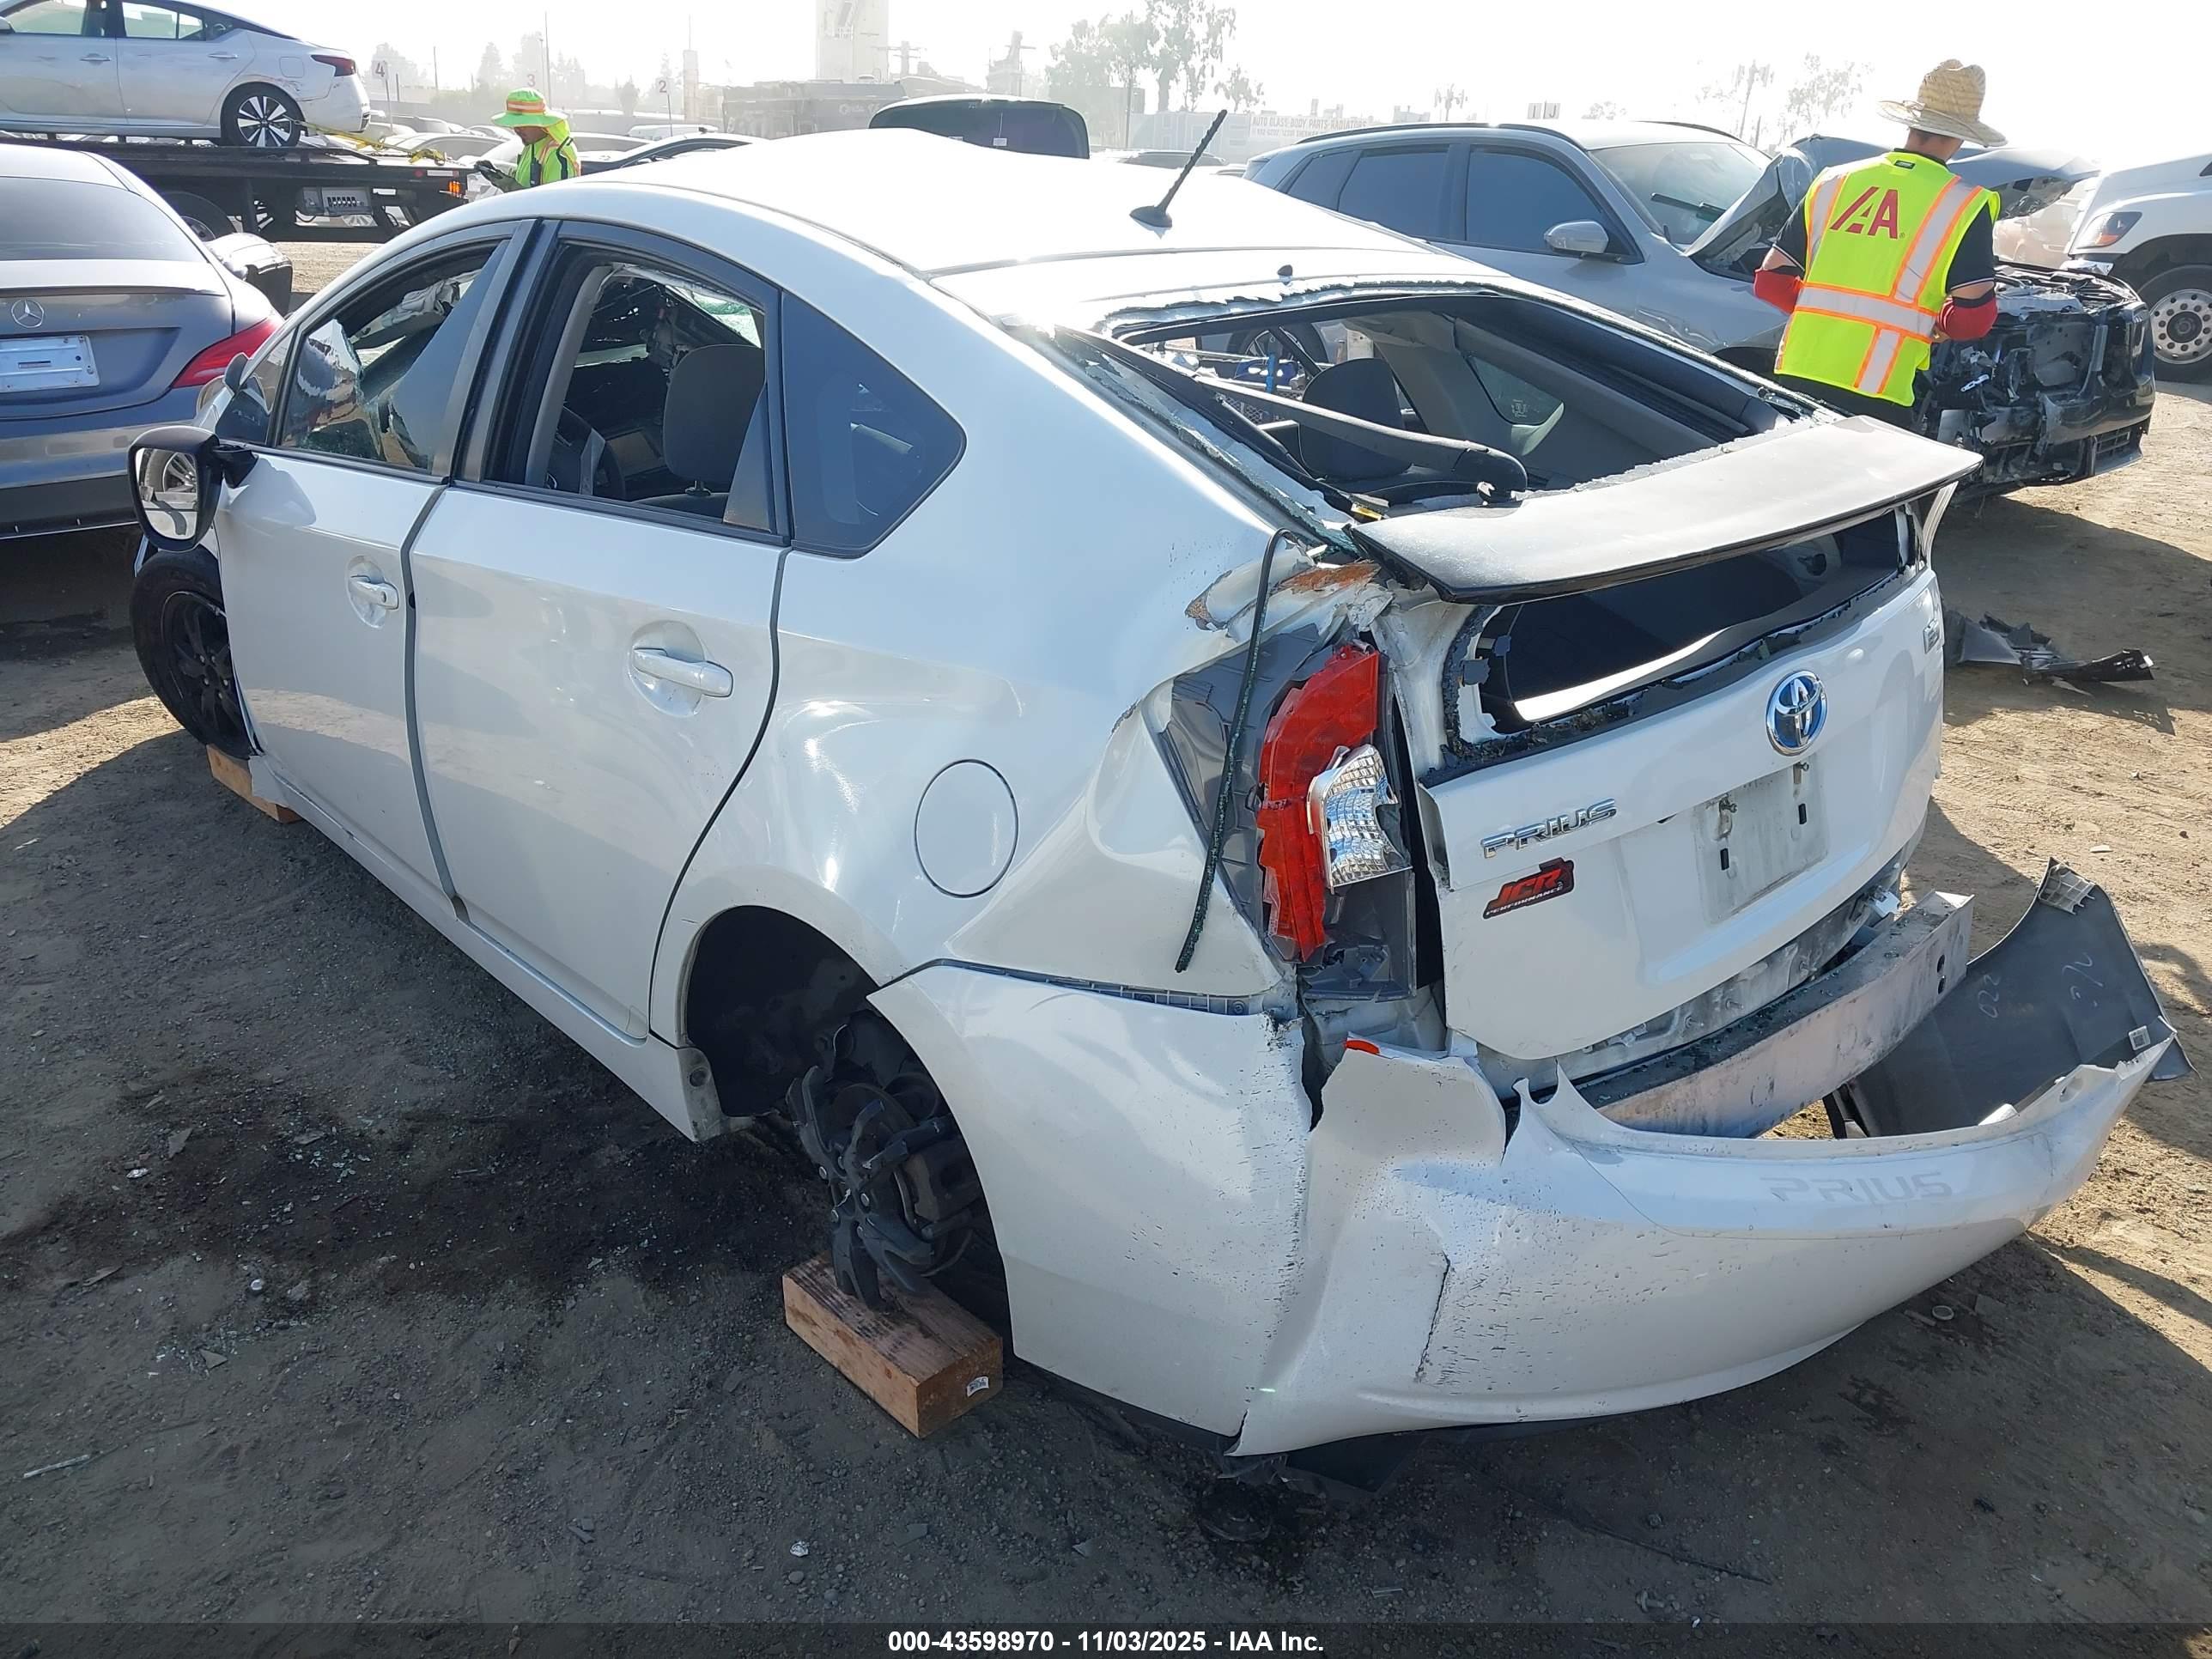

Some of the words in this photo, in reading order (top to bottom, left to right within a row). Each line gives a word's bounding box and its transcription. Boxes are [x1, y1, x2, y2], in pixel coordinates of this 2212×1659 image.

[374, 61, 386, 77] 4
[526, 74, 536, 88] 3
[659, 80, 667, 93] 2
[1252, 116, 1268, 126] AUTO
[1480, 798, 1617, 859] PRIUS
[1492, 867, 1562, 906] JCR
[1759, 1171, 1954, 1203] PRIUS
